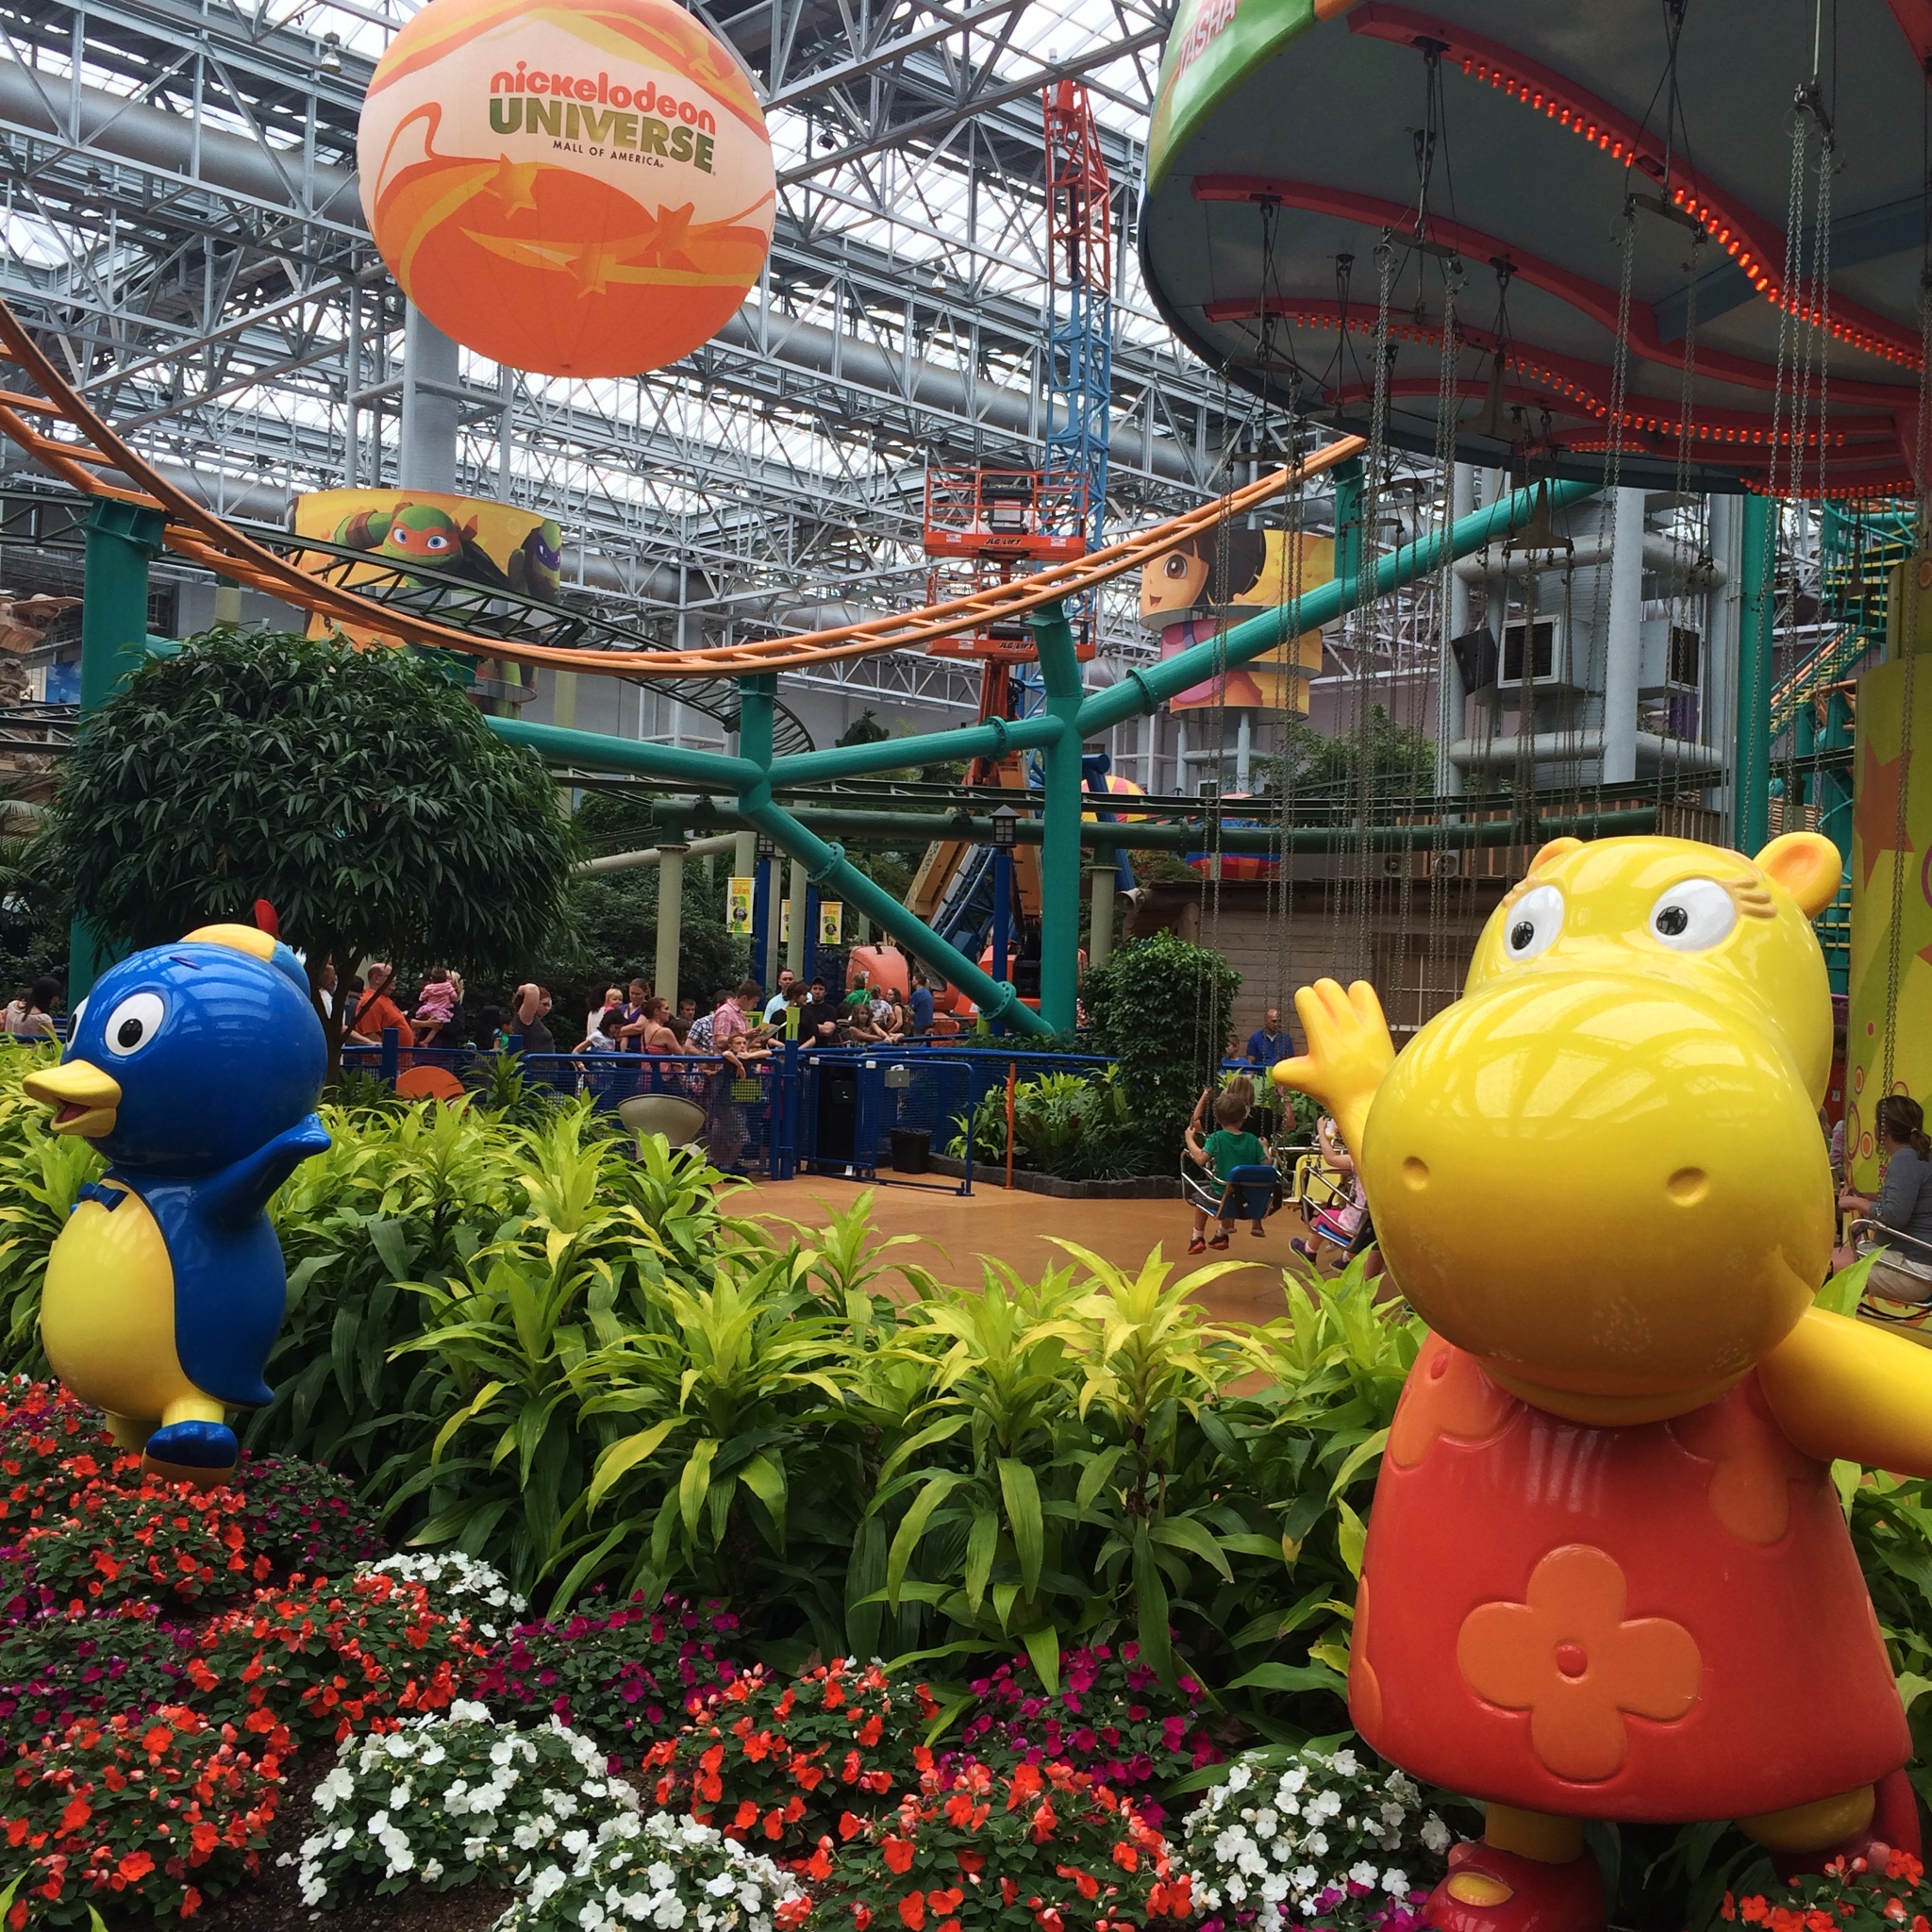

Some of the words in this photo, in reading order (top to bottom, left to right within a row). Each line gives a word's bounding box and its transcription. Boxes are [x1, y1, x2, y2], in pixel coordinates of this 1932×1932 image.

[1178, 0, 1235, 78] TASHA
[490, 60, 716, 135] nickelodeon
[490, 97, 715, 175] UNIVERSE
[553, 140, 584, 154] MALL
[589, 146, 605, 157] OF
